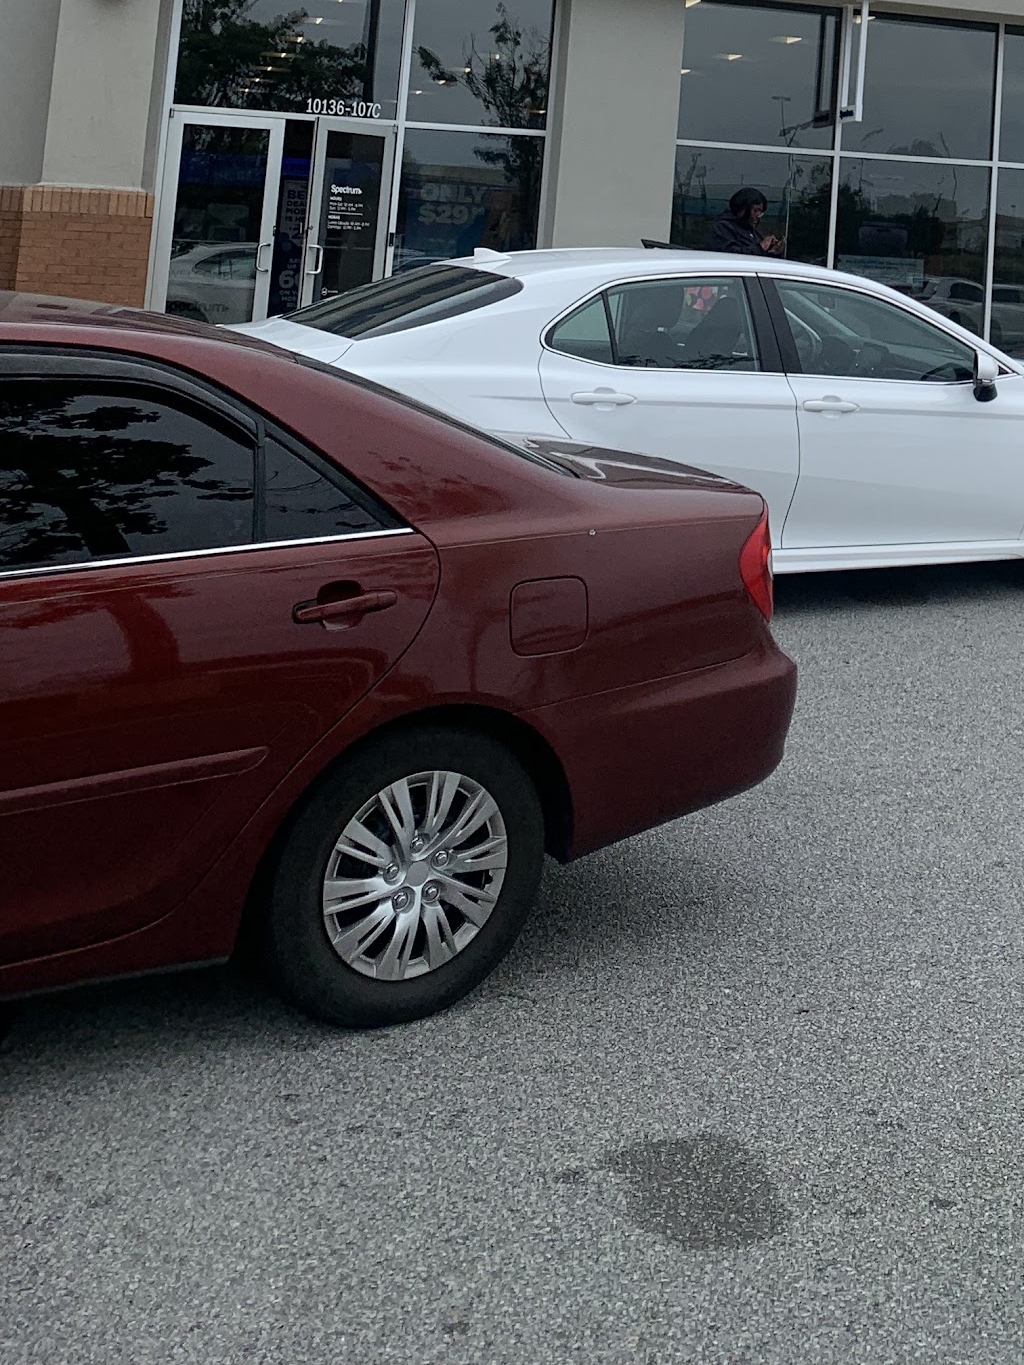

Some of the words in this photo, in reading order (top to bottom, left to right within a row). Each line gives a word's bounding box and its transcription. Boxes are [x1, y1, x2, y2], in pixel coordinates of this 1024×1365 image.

[305, 97, 381, 119] 10136-107C
[330, 184, 360, 195] Spectrum
[420, 182, 487, 203] ONLY
